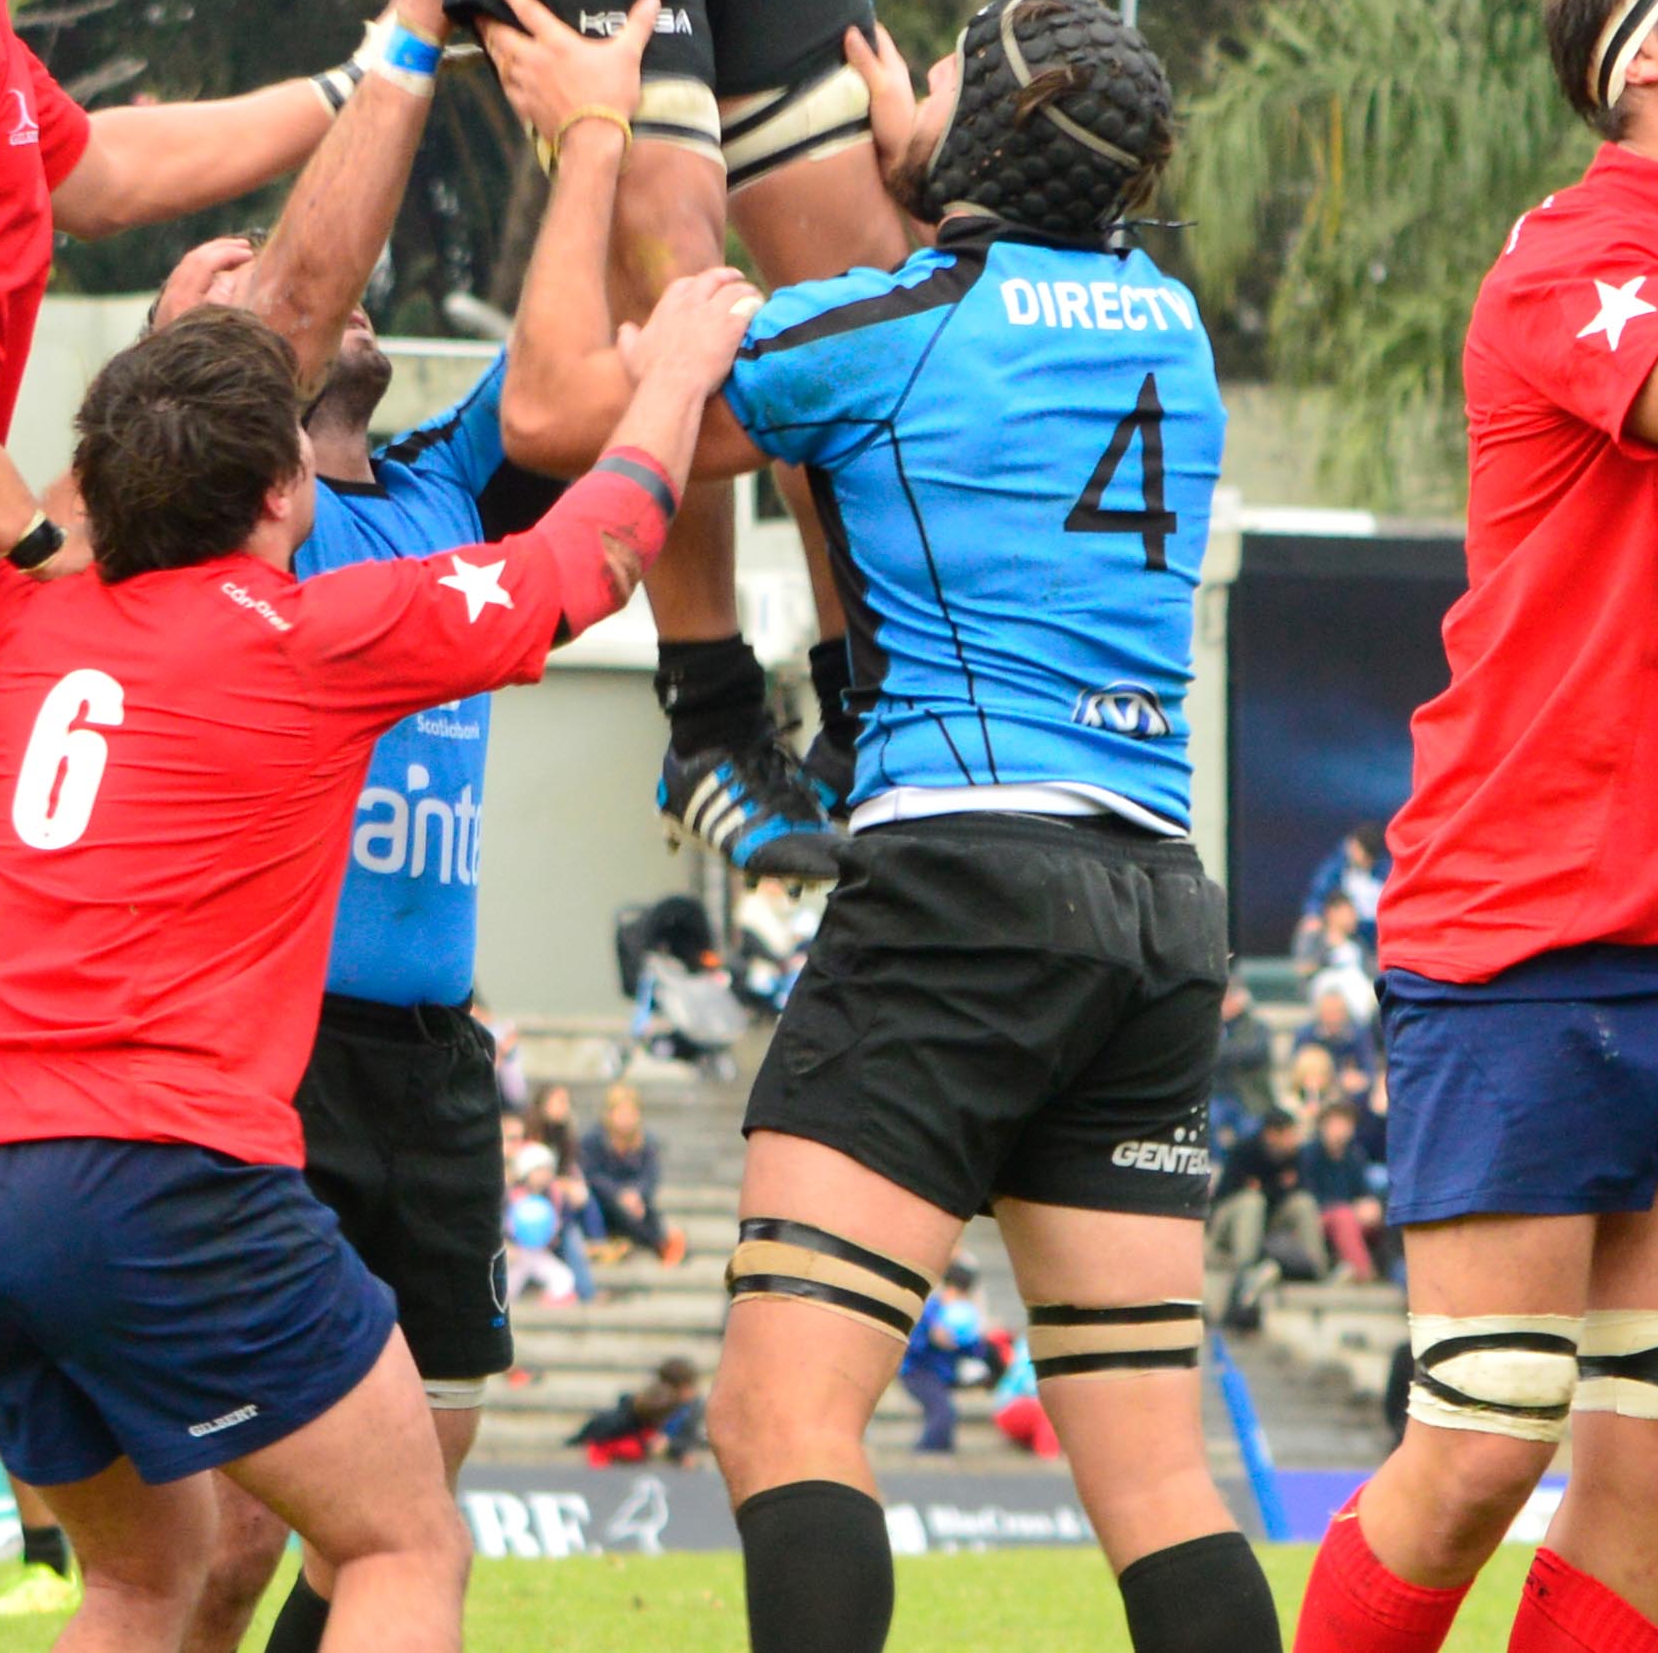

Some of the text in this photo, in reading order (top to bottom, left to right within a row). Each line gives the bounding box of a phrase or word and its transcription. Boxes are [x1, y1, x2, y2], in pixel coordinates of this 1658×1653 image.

[579, 8, 692, 36] KOGA
[1064, 372, 1177, 571] 4
[11, 668, 125, 850] 6
